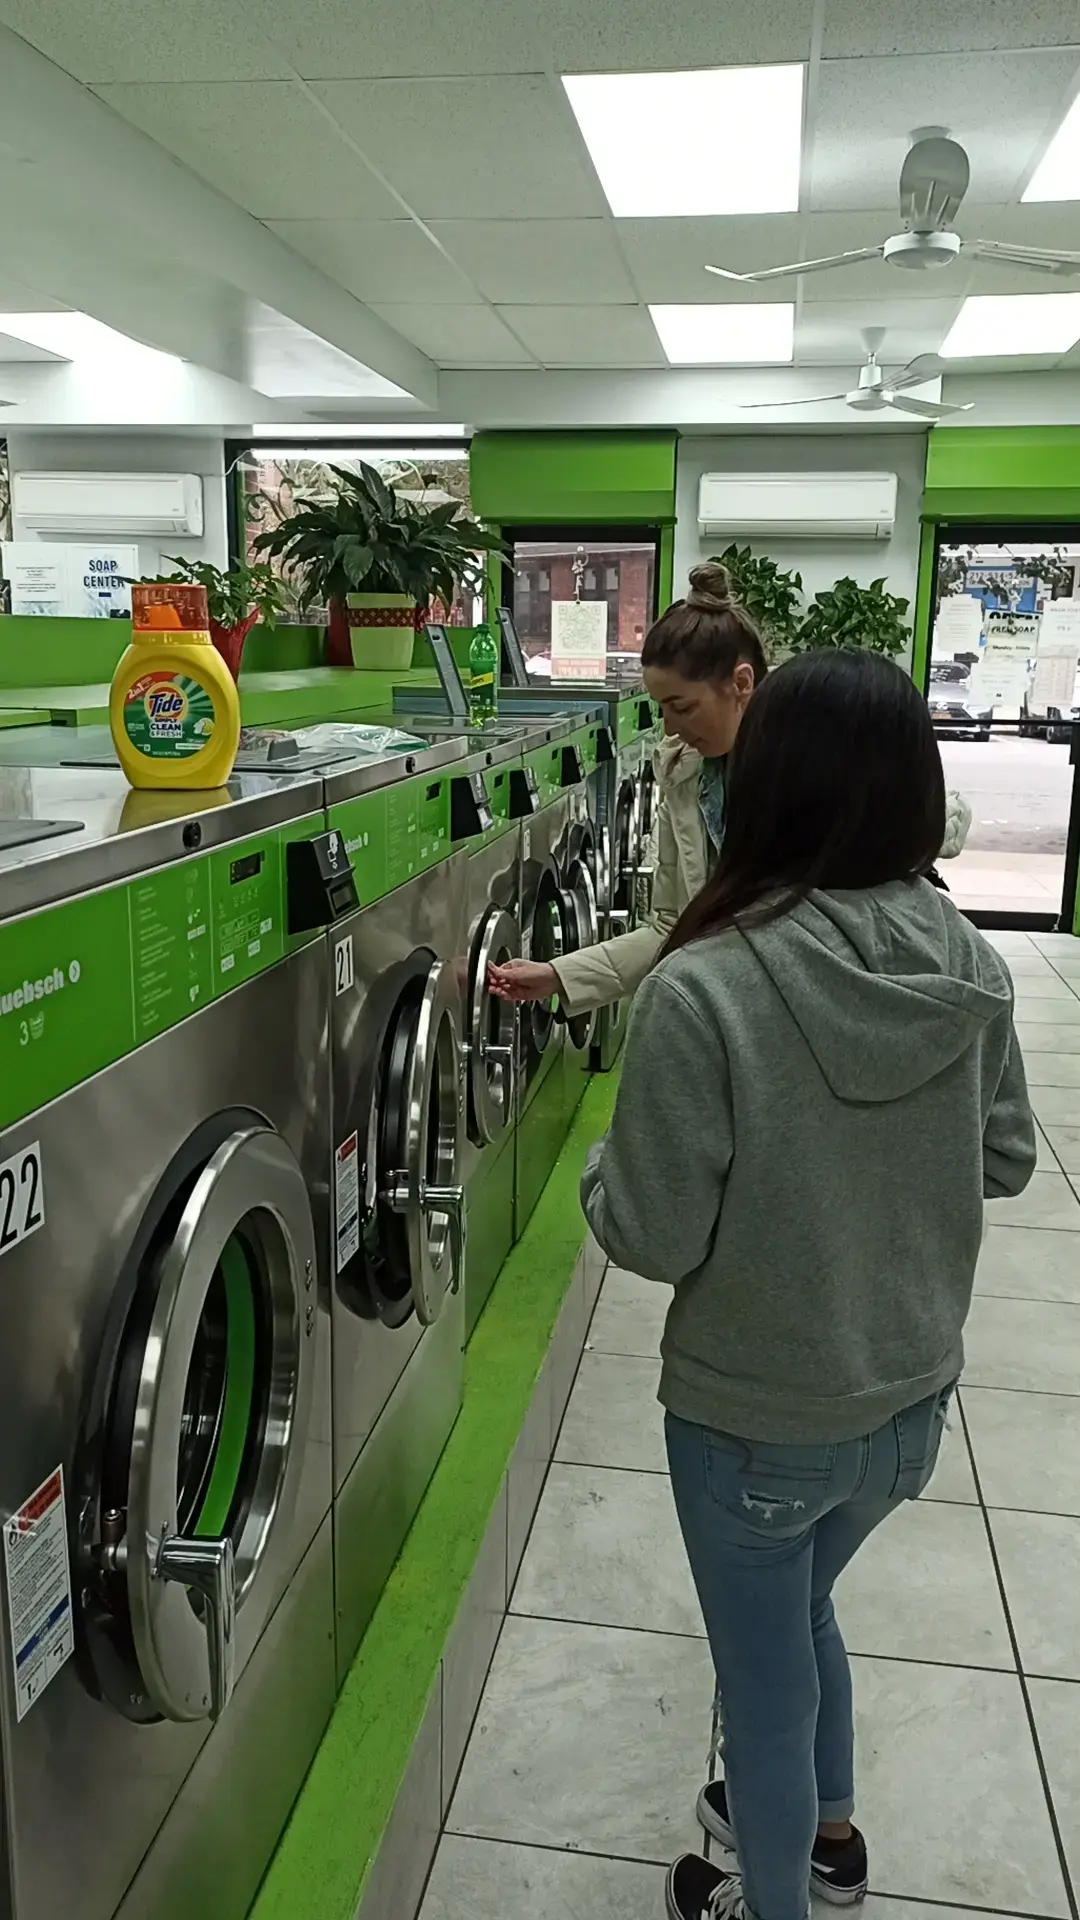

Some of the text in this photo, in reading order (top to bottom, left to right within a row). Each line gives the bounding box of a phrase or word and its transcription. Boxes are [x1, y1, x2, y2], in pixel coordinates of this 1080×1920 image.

[88, 559, 117, 572] SOAP
[148, 692, 184, 718] Tide
[150, 723, 182, 731] CLEAN
[337, 940, 352, 992] 21
[0, 967, 64, 1016] uebsch
[20, 1020, 29, 1046] 3
[0, 1153, 42, 1251] 22
